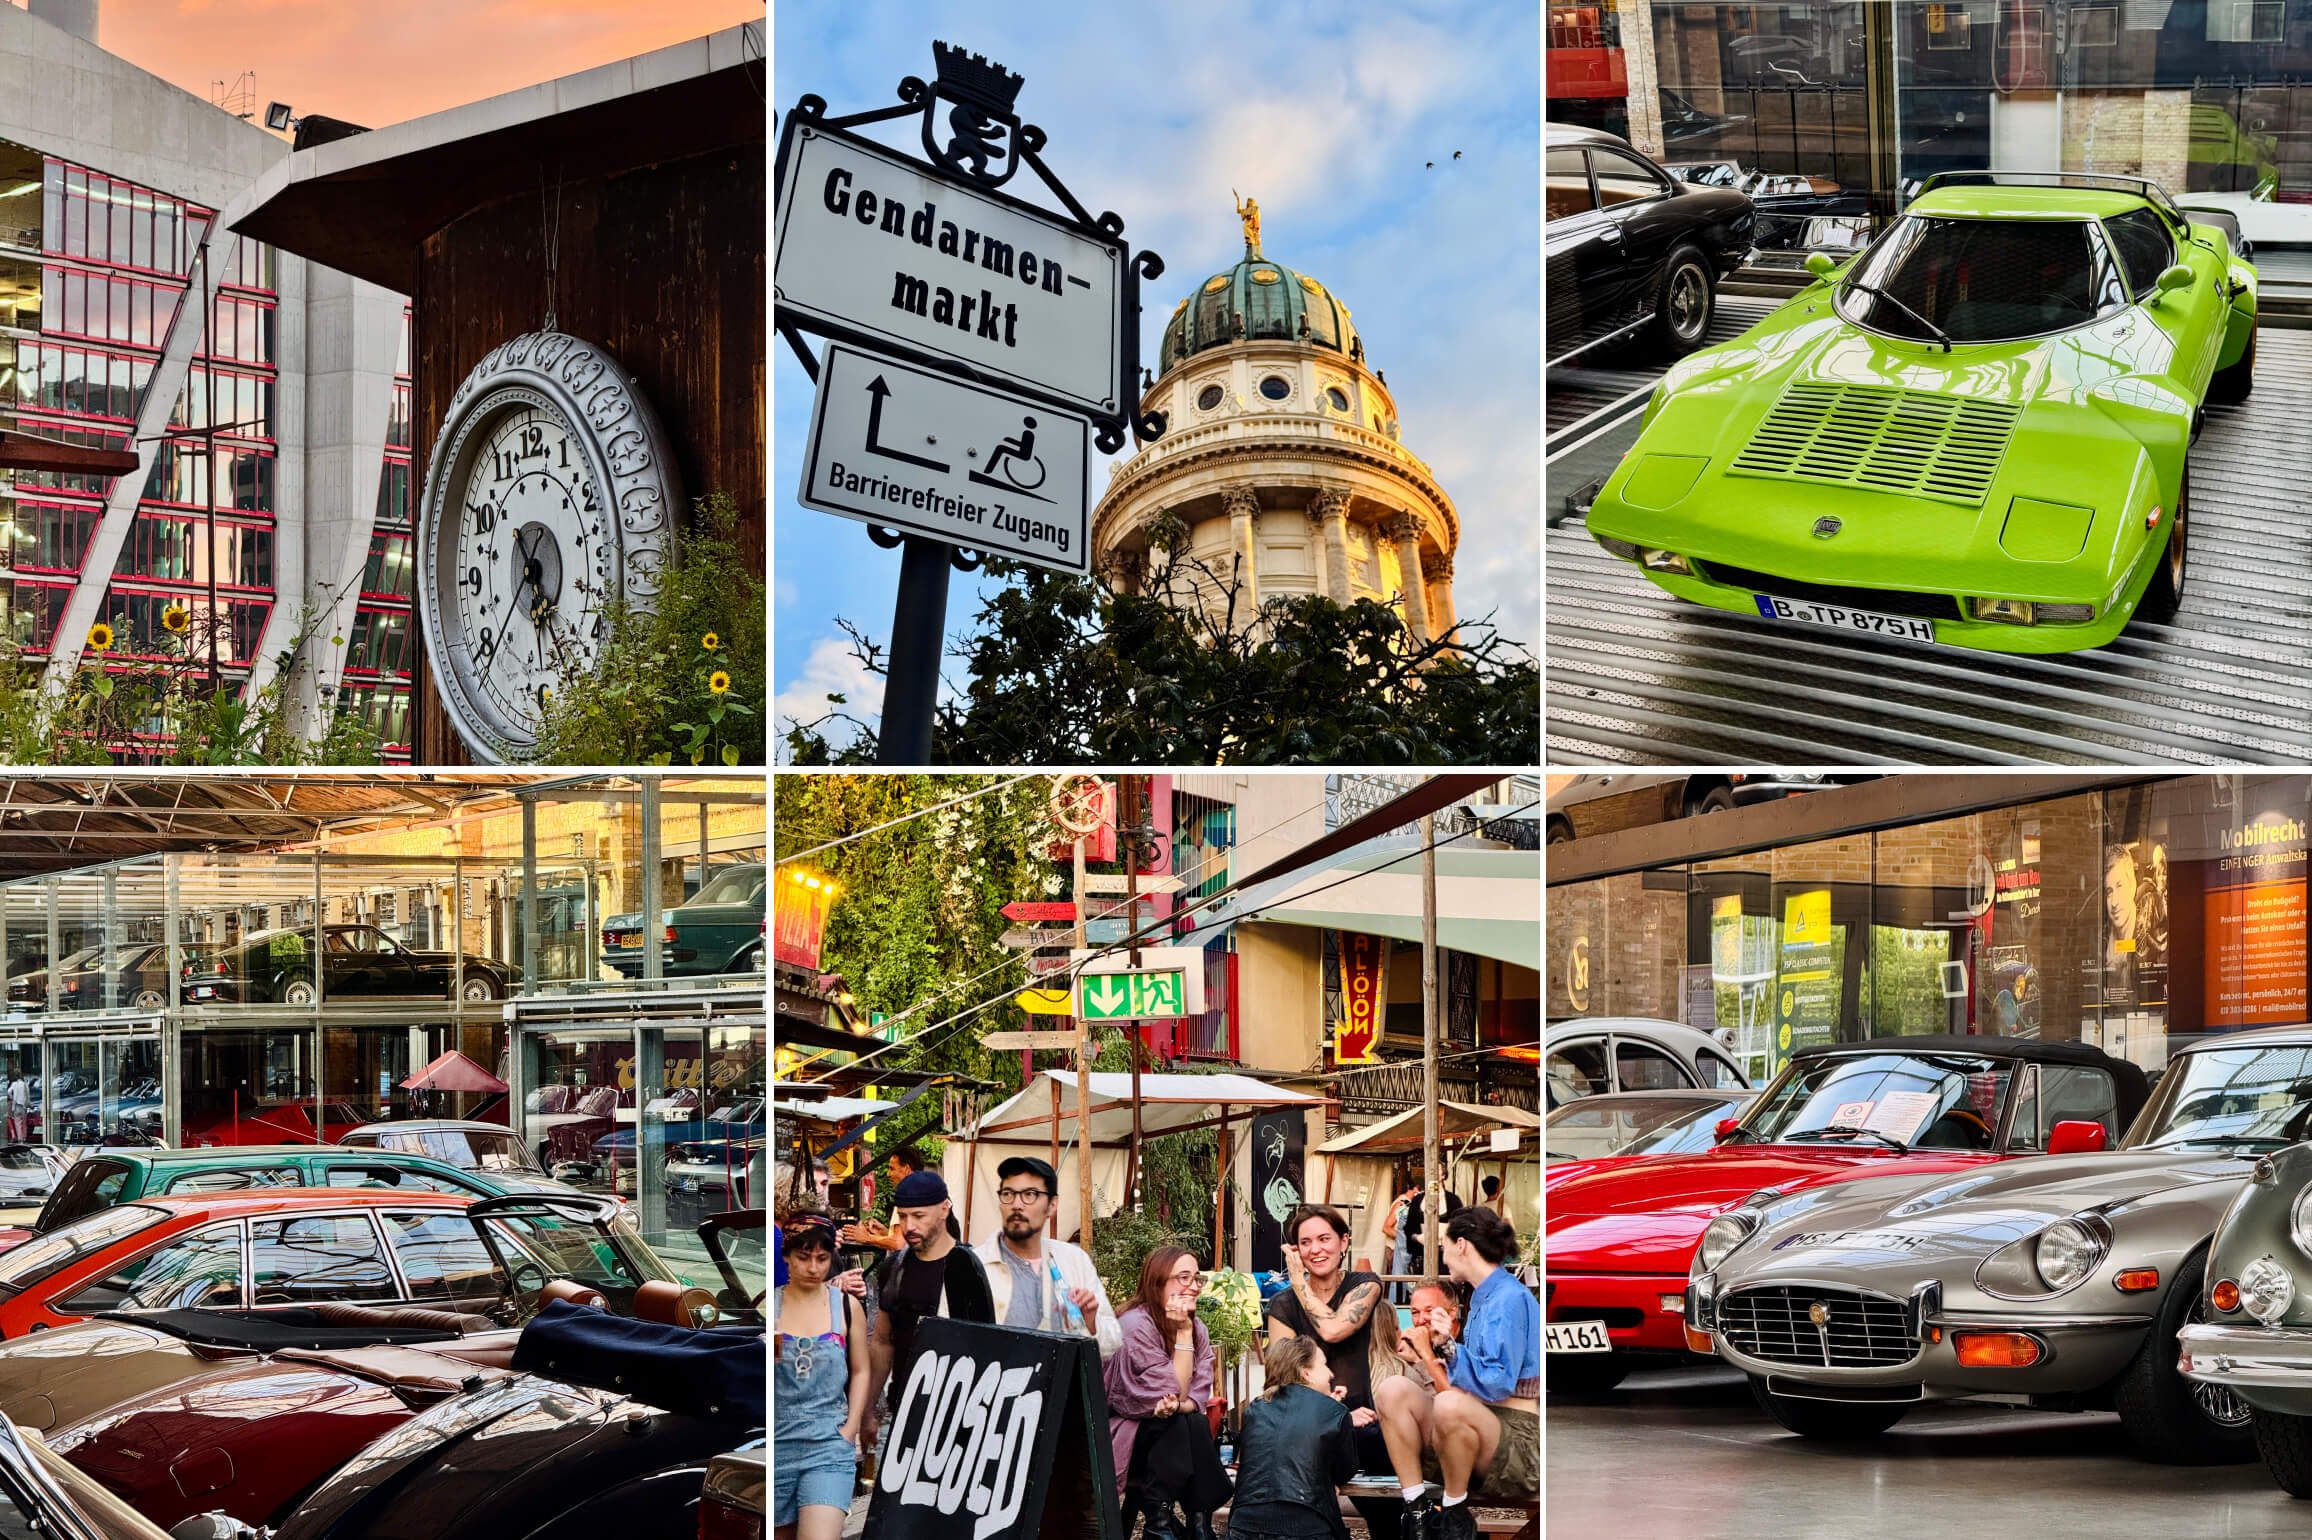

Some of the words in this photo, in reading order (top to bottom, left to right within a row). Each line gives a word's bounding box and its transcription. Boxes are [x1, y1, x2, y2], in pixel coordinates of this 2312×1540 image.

[891, 271, 1018, 348] markt
[519, 426, 545, 460] 12
[557, 438, 571, 469] 1
[493, 450, 514, 482] 11
[582, 481, 597, 512] 2
[829, 461, 988, 525] Barrierefreier
[992, 504, 1070, 553] Zugang
[474, 503, 495, 536] 10
[468, 566, 483, 597] 9
[1773, 599, 1795, 618] B
[1808, 605, 1846, 626] TP
[479, 626, 495, 658] 8
[2221, 817, 2306, 850] Mobilrecht
[1029, 932, 1056, 947] BAR
[1563, 1325, 1606, 1349] 161
[881, 1350, 1043, 1540] CLOSED
